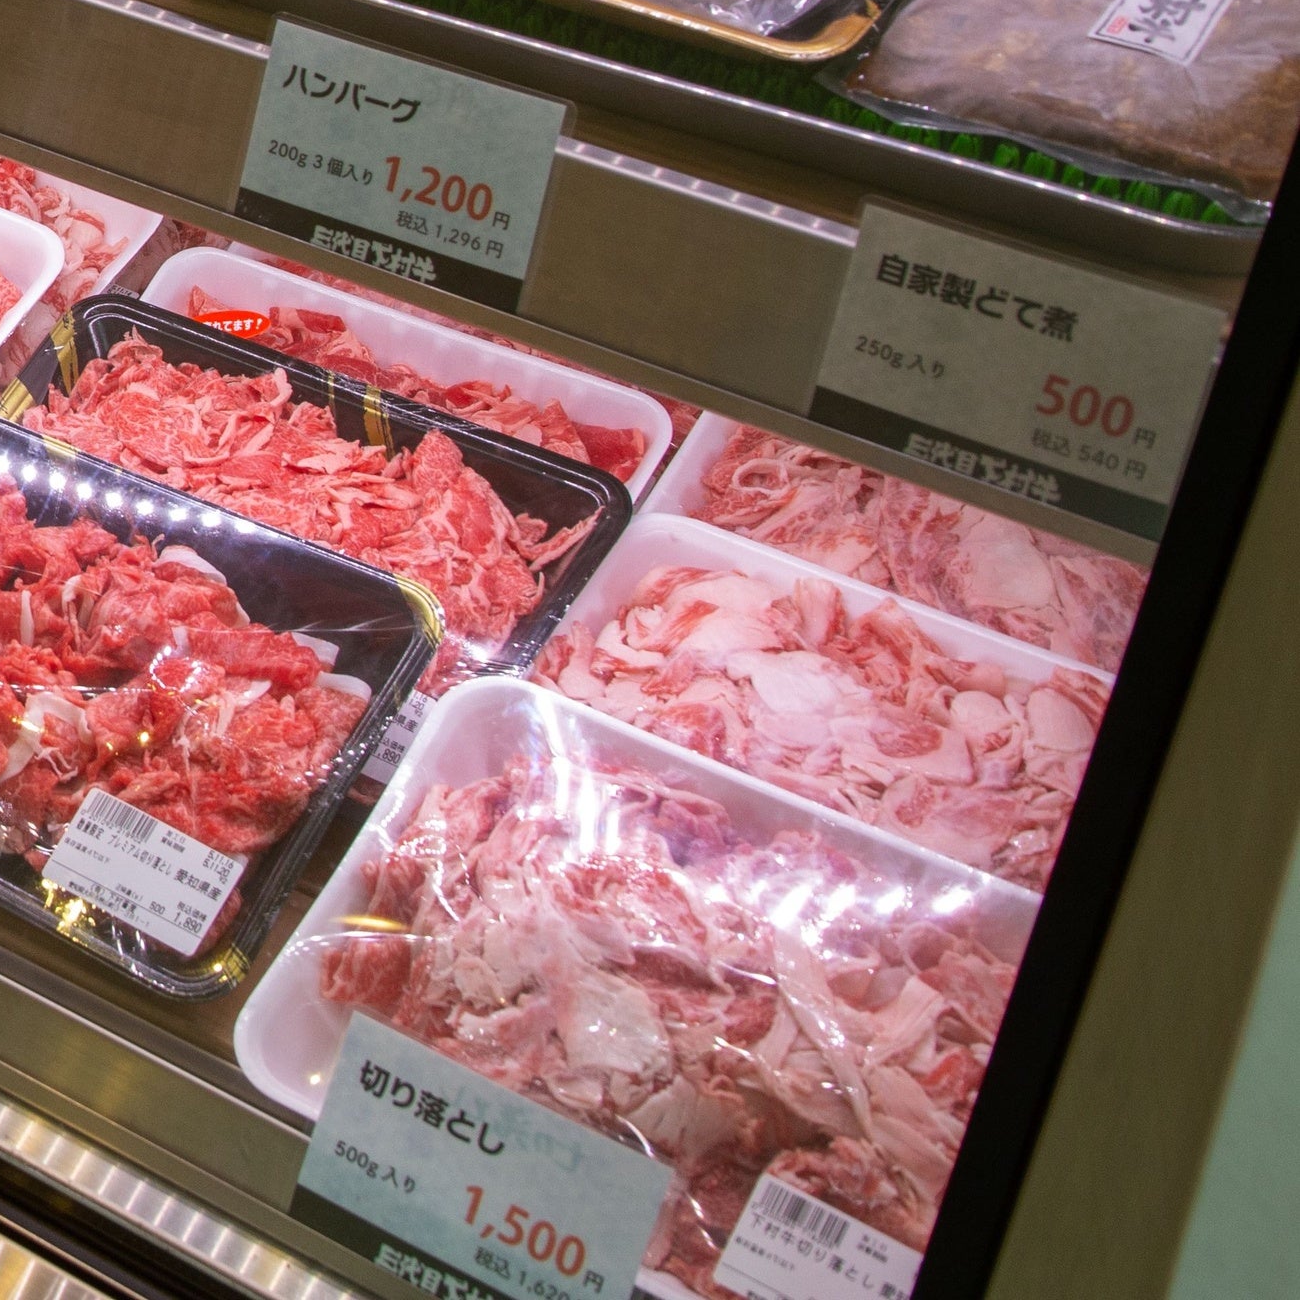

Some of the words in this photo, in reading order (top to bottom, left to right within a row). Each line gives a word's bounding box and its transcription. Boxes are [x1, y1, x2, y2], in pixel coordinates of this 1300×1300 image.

[282, 64, 422, 123] ハンバーグ
[268, 140, 308, 169] 200g
[313, 154, 324, 170] 3
[327, 158, 374, 186] 個入り
[385, 156, 494, 222] 1,200
[492, 211, 511, 231] 円
[396, 210, 429, 235] 税込
[435, 223, 482, 252] 1,296
[485, 239, 504, 259] 円
[876, 253, 1080, 343] 自家製どて煮
[855, 334, 904, 370] 250g
[907, 353, 947, 379] 入り
[1034, 373, 1136, 439] 500
[1133, 426, 1157, 450] 円
[1029, 426, 1072, 460] 税込
[1078, 444, 1120, 473] 540
[1124, 457, 1148, 481] 円
[173, 868, 223, 902] 愛知県産
[203, 860, 230, 877] 5.11.20
[208, 850, 234, 869] 5.11.16
[173, 912, 203, 933] 1,890
[359, 1058, 506, 1157] 切り落とし
[333, 1139, 380, 1180] 500g
[380, 1167, 417, 1195] 入り
[463, 1184, 586, 1278] 1,500
[581, 1269, 605, 1294] 円
[474, 1245, 512, 1281] 税込
